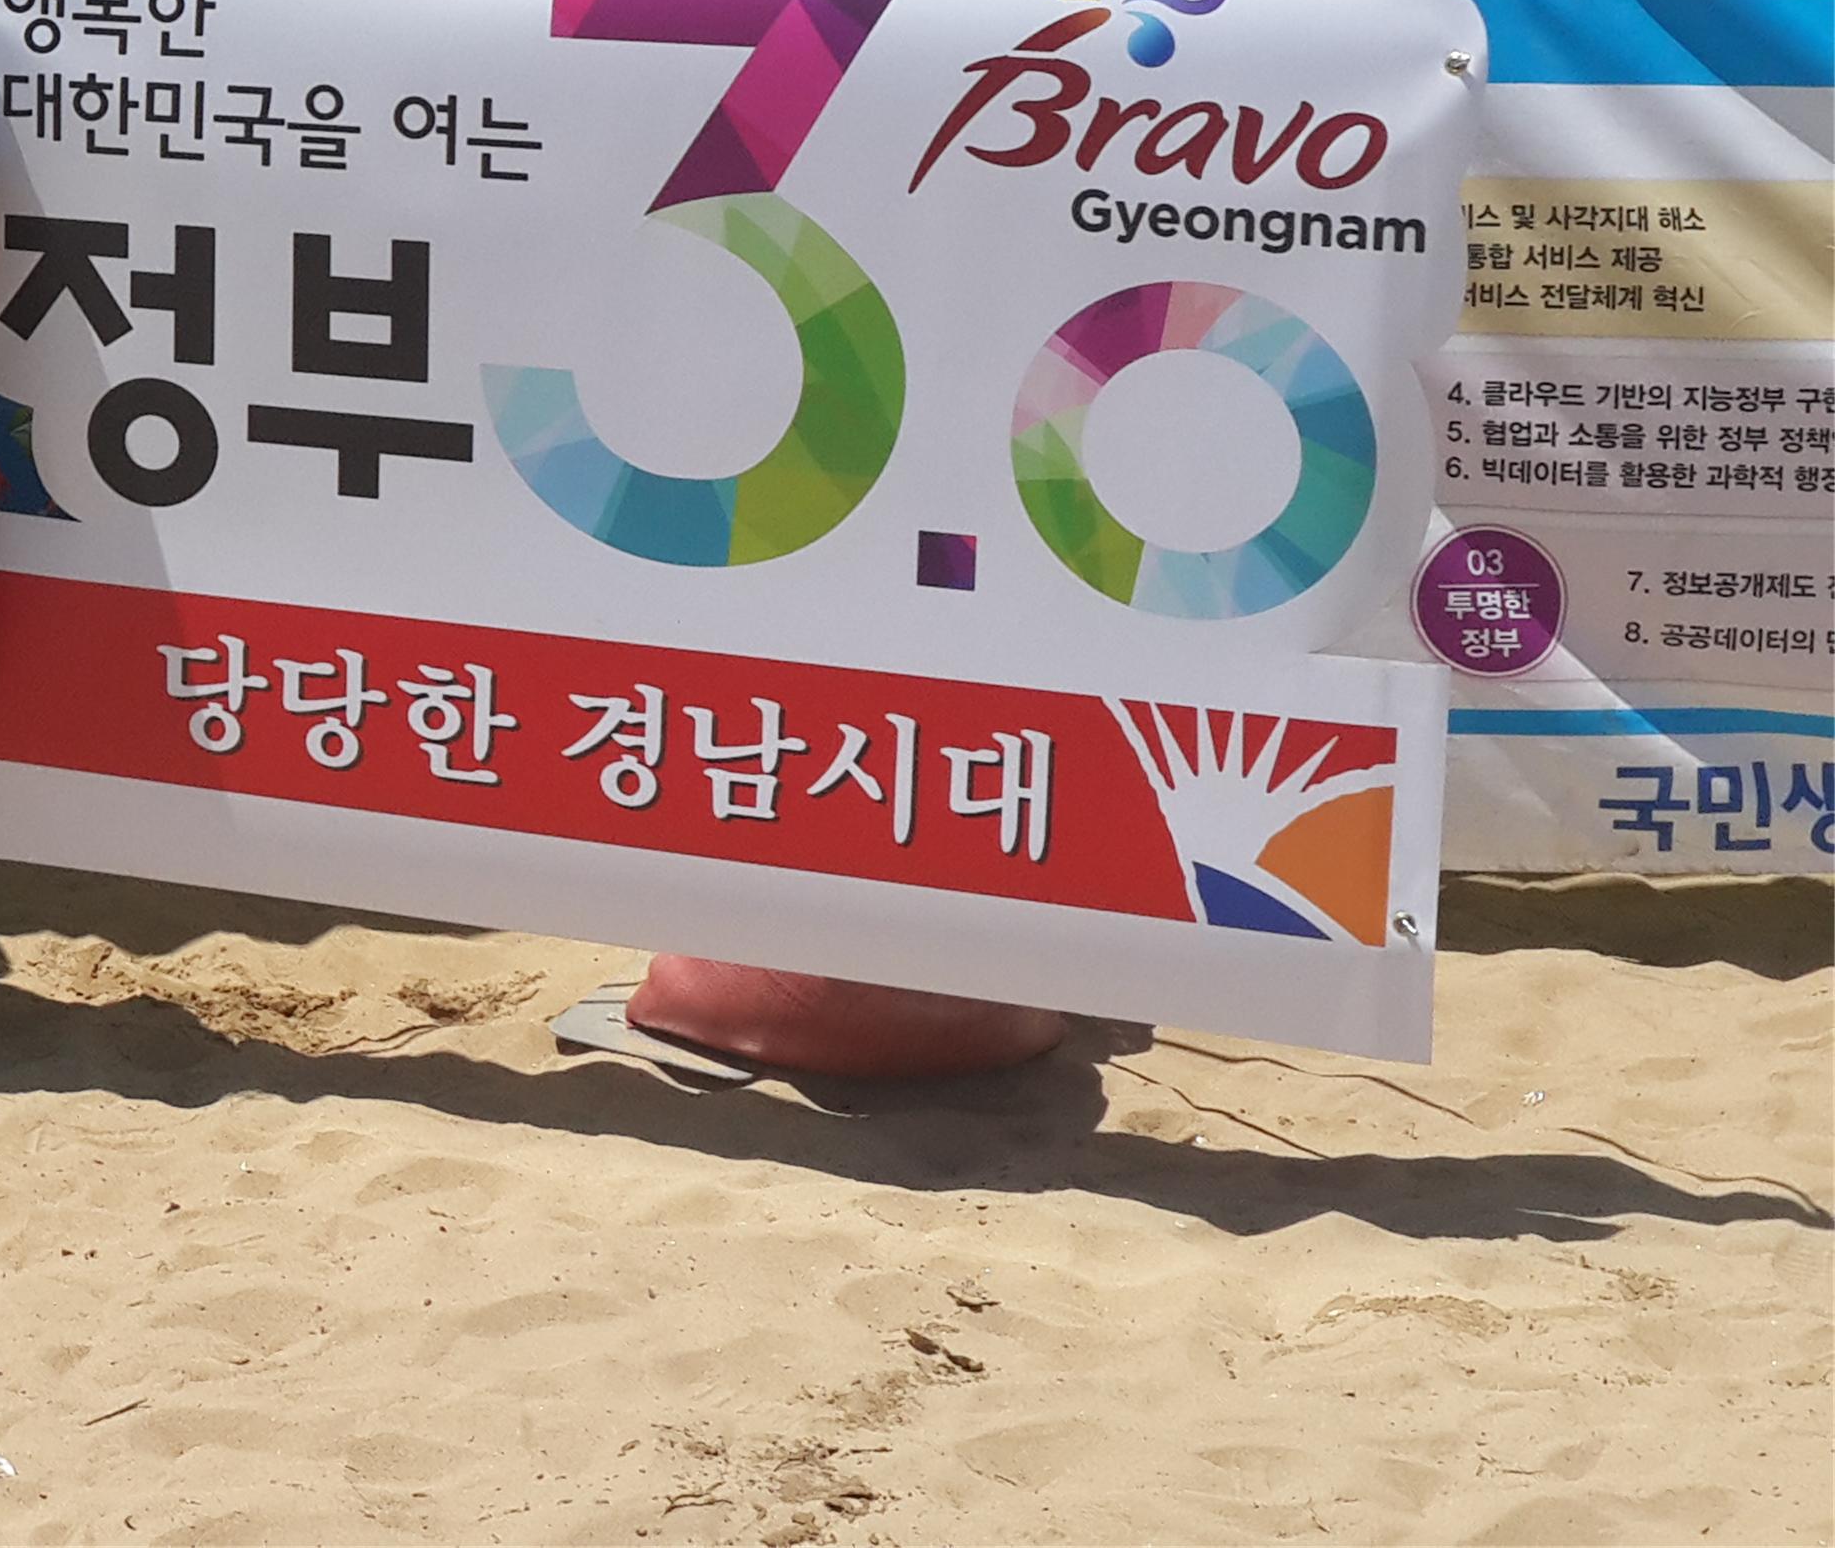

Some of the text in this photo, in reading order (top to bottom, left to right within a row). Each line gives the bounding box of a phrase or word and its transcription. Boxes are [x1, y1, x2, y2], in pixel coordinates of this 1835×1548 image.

[910, 6, 1388, 195] Bravo
[0, 72, 544, 184] 대한민국을 여는
[1071, 187, 1427, 256] Gyeongnam
[1511, 204, 1535, 230] 및
[1546, 205, 1649, 232] 사각지대
[1658, 206, 1707, 233] 해소
[1524, 245, 1601, 272] 서비스
[1611, 246, 1663, 273] 제공
[1539, 284, 1643, 311] 전달체계
[1652, 285, 1705, 313] 혁신
[1447, 381, 1471, 407] 4.
[1482, 381, 1585, 408] 클라우드
[1596, 383, 1673, 410] 기반의
[1683, 384, 1786, 412] 지능정부
[1447, 419, 1471, 445] 5.
[1482, 420, 1560, 448] 협업과
[1569, 422, 1646, 450] 소통을
[1656, 423, 1707, 451] 위한
[1718, 425, 1770, 453] 정부
[1446, 456, 1471, 482] 6.
[1482, 457, 1610, 488] 빅데이터를
[1619, 460, 1698, 490] 활용한
[1706, 463, 1786, 492] 과학적
[1466, 549, 1504, 576] 03
[1627, 571, 1817, 601] 7. 정보공개제도
[1445, 589, 1532, 622] 투명한
[1460, 628, 1523, 660] 정부
[1624, 623, 1816, 655] 8. 공공데이터의
[156, 634, 1056, 862] 당당한 경남시대
